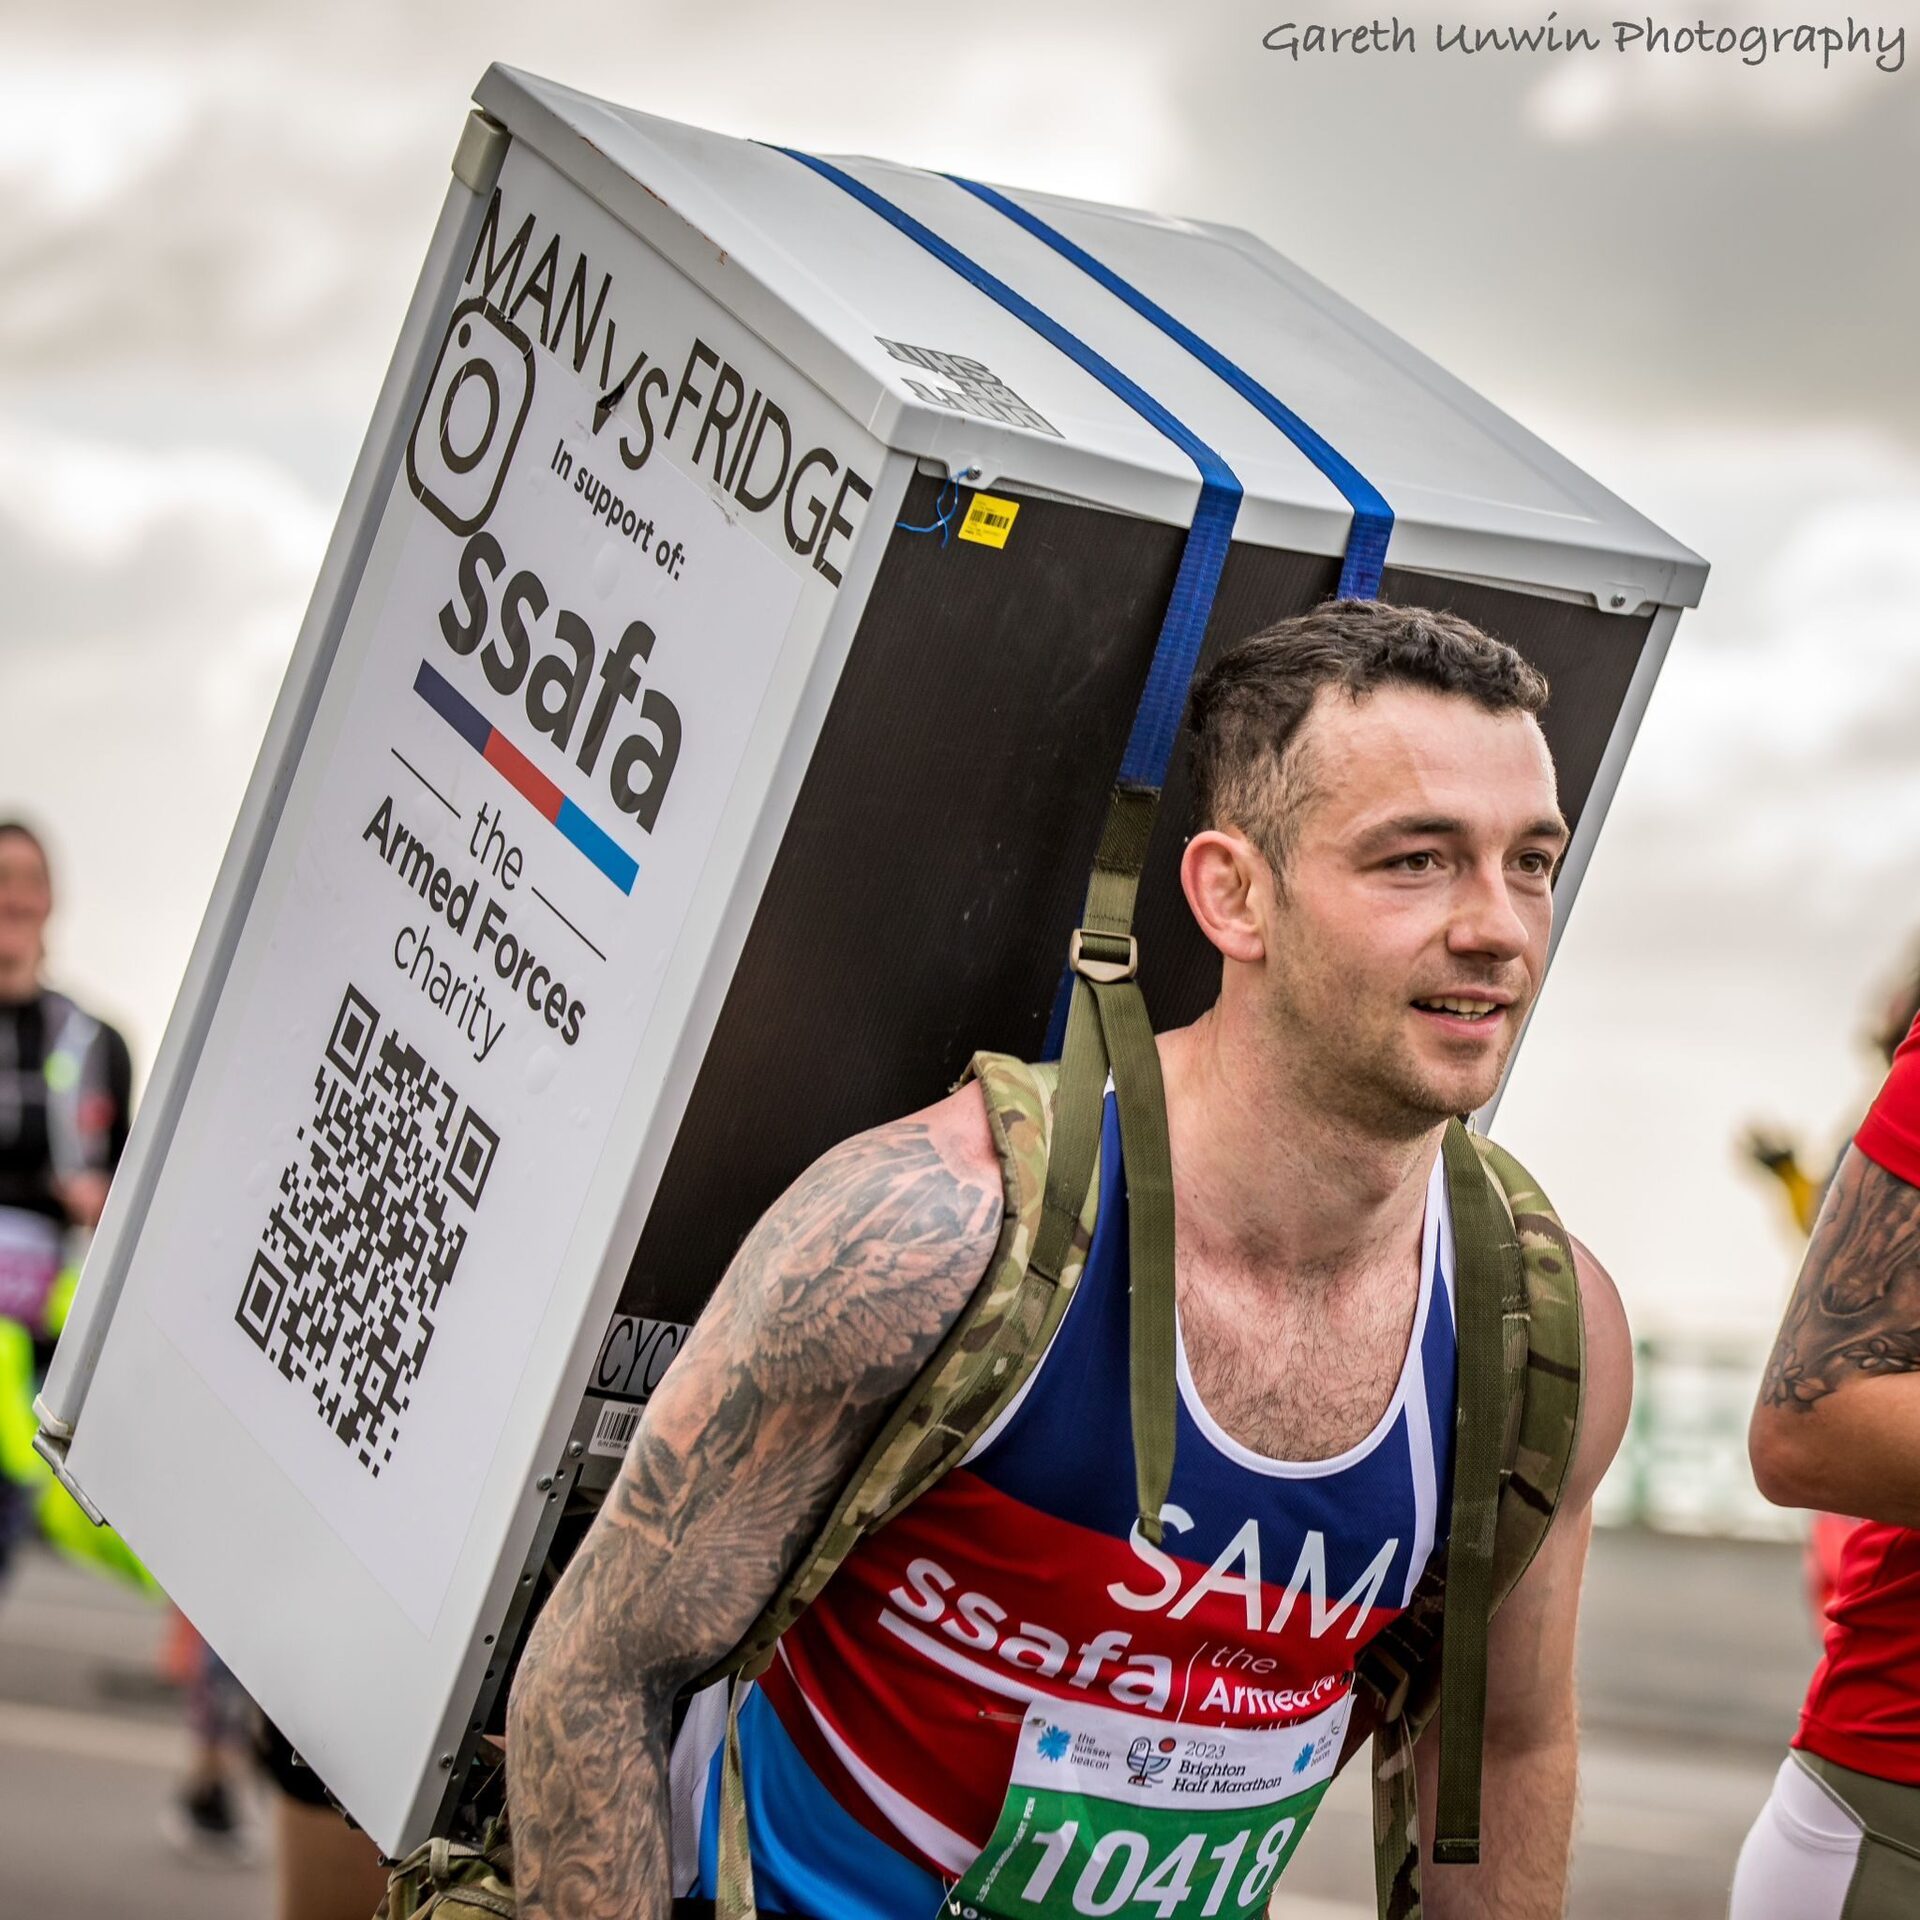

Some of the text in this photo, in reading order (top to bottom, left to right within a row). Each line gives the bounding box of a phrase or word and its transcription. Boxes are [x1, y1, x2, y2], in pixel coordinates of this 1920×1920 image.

[549, 438, 686, 582] In support of:
[664, 337, 873, 589] FRIDGE
[438, 531, 682, 835] ssafa
[469, 801, 523, 891] the
[362, 796, 587, 1047] Armed Forces
[394, 925, 506, 1063] charity
[1106, 1503, 1399, 1640] SAM
[889, 1557, 1172, 1713] ssafa
[1211, 1646, 1277, 1673] the
[1070, 1753, 1110, 1771] beacon
[1074, 1743, 1111, 1759] sussex
[1077, 1732, 1095, 1744] the
[1171, 1776, 1282, 1794] Half Marathon
[1178, 1759, 1246, 1780] Brighton
[1184, 1740, 1226, 1759] 2023
[1020, 1817, 1297, 1919] 10418
